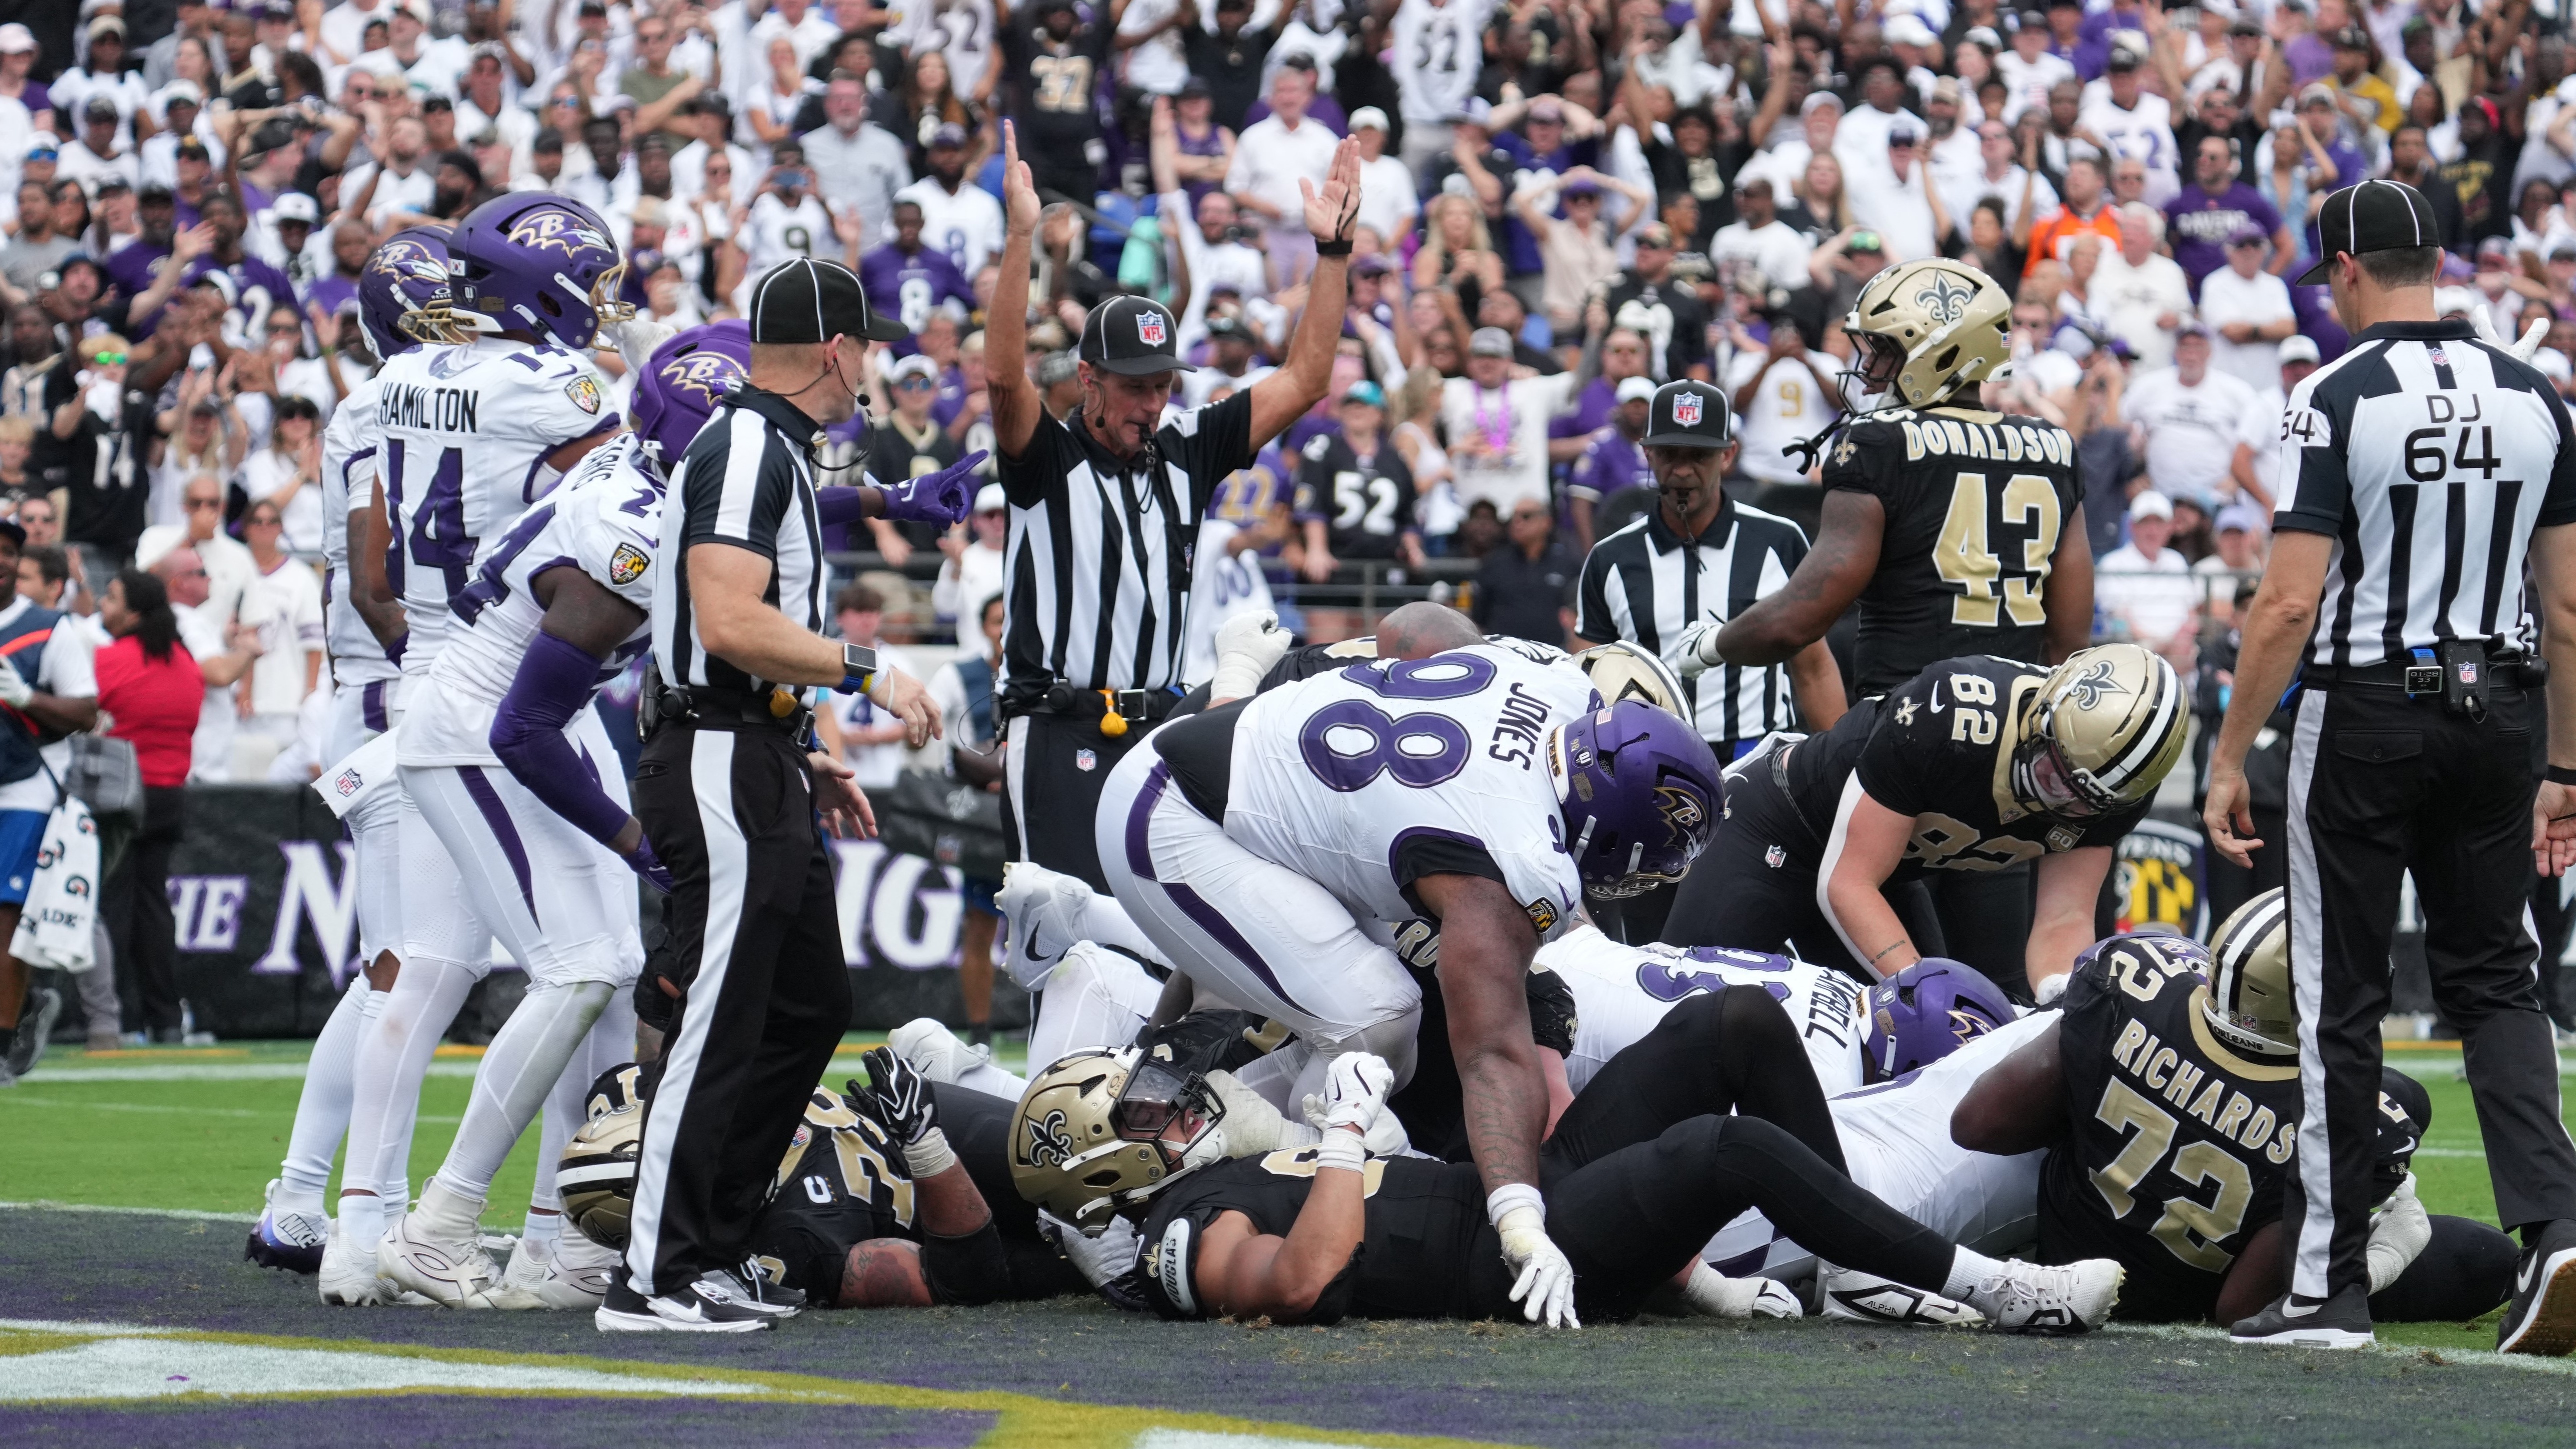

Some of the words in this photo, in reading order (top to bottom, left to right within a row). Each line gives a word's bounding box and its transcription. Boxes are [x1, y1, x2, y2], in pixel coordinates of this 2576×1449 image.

[1030, 55, 1094, 114] 37
[900, 278, 933, 334] 8
[1142, 326, 1164, 342] NFL
[2432, 355, 2448, 364] NFL
[566, 376, 588, 392] RAVENS
[1782, 383, 1801, 417] 9
[380, 382, 479, 433] HAMILTON
[1676, 406, 1700, 422] NFL
[2426, 394, 2482, 424] DJ
[1902, 420, 2074, 468] DONALDSON
[2404, 426, 2502, 482] 64
[1333, 470, 1400, 536] 52
[384, 436, 480, 606] 14
[622, 543, 648, 564] RAVENS
[1932, 472, 2062, 628] 43
[2462, 672, 2475, 681] NFL
[1301, 653, 1498, 793] 98
[1950, 671, 1998, 746] 82
[1488, 682, 1552, 772] JONES
[1079, 758, 1094, 768] NFL
[1548, 726, 1562, 778] AVENS
[338, 776, 354, 795] NFL
[2050, 830, 2074, 848] 60
[2118, 834, 2193, 868] VENS
[1768, 854, 1782, 866] NFL
[1540, 900, 1556, 921] RAVENS
[1804, 968, 1860, 1050] AMPBELL
[2243, 1021, 2256, 1029] NFL
[2214, 1026, 2264, 1051] ORLEANS
[2113, 1018, 2298, 1164] RICHARDS
[2088, 1075, 2254, 1274] 72
[278, 1213, 318, 1250] NIKE
[728, 1272, 744, 1288] Conditions
[1864, 1300, 1899, 1316] ALPHA
